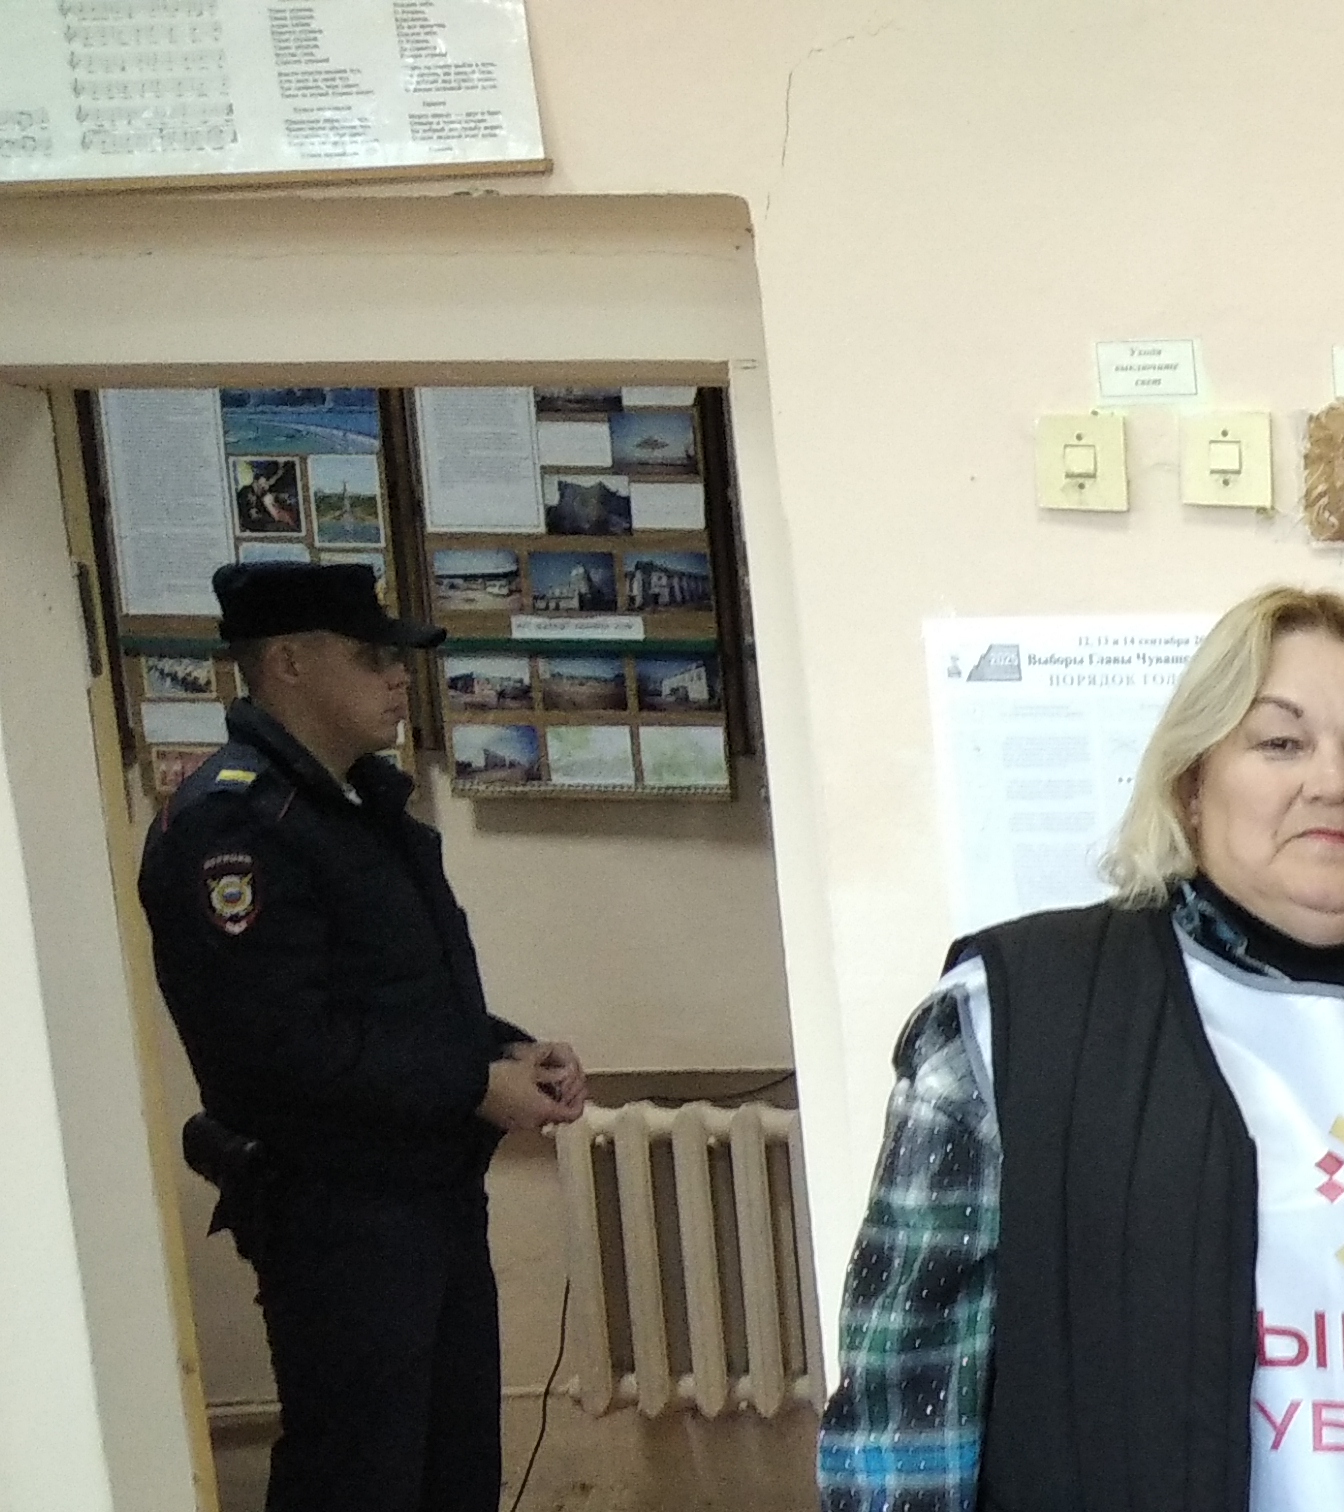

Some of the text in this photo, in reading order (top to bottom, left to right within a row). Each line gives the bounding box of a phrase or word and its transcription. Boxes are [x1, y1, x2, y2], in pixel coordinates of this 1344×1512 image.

[1027, 653, 1085, 668] Выборы
[1088, 653, 1132, 666] Главы
[1048, 673, 1178, 688] ПОРЯДОК ГОЛ
